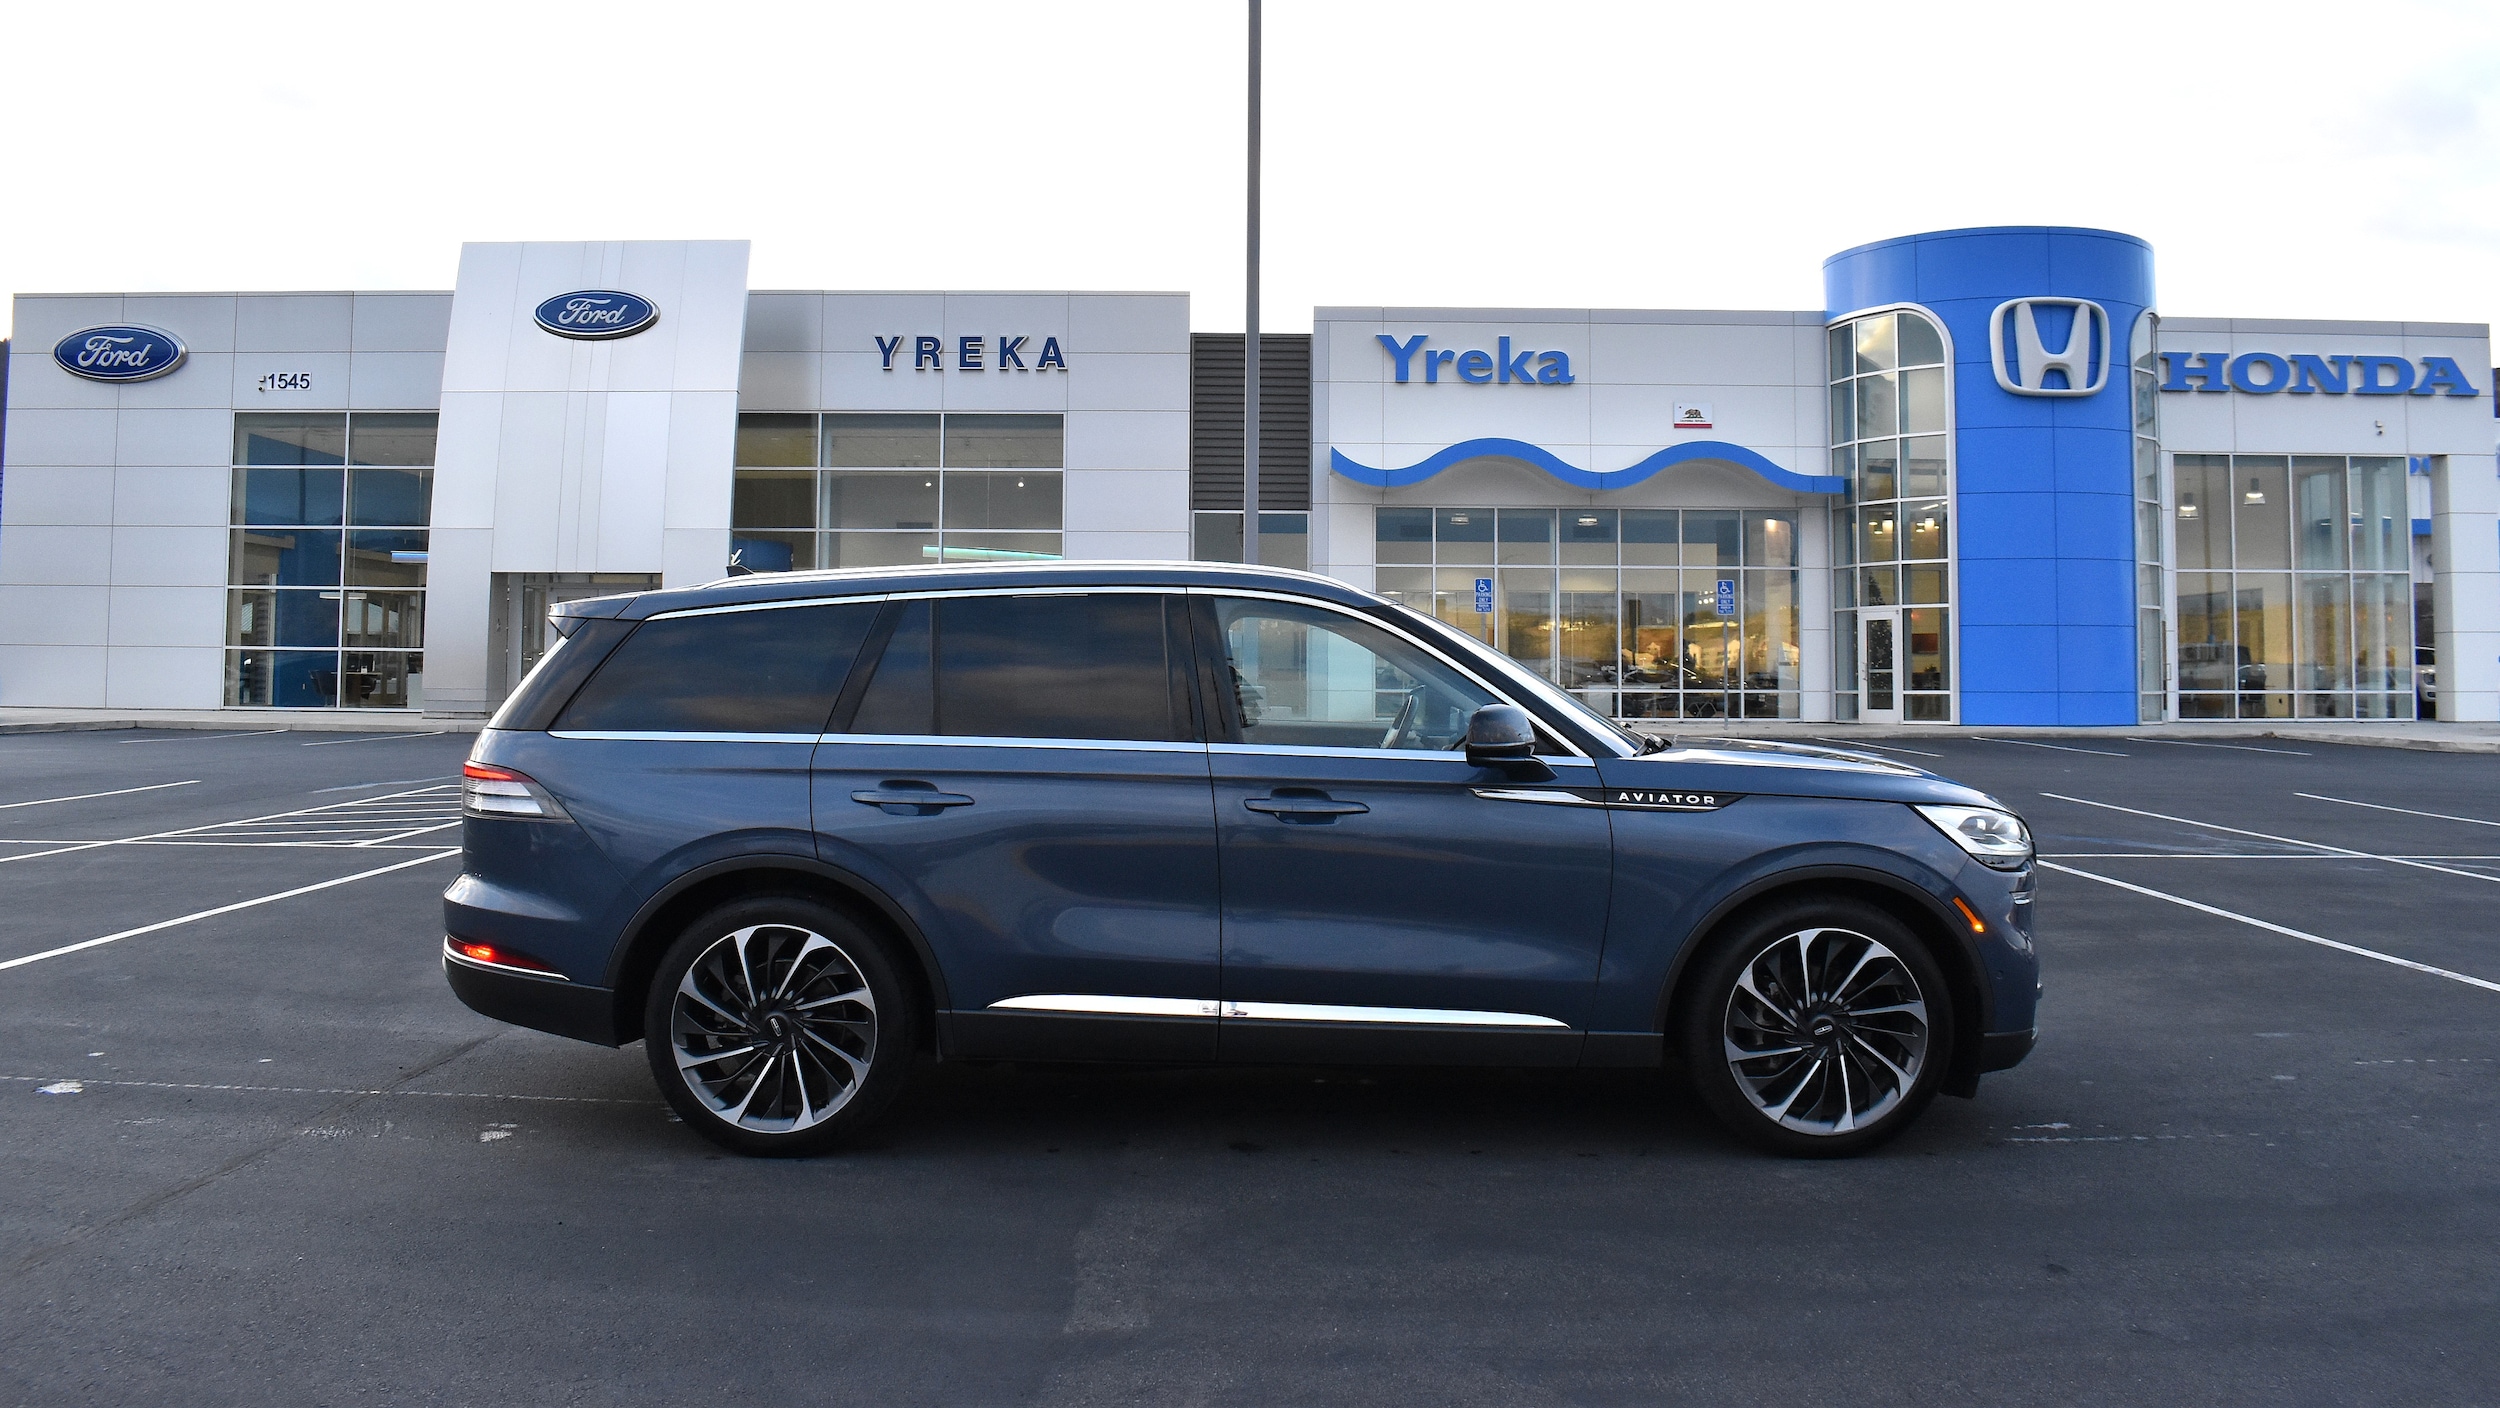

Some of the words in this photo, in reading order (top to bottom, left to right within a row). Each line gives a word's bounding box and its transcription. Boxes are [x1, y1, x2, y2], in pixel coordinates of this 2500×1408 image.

[558, 297, 628, 325] Ford
[77, 335, 152, 367] Ford
[873, 334, 1068, 371] YREKA
[1375, 334, 1576, 385] Yreka
[268, 373, 310, 389] 1545
[2159, 351, 2480, 397] HONDA
[1619, 792, 1715, 805] AVIATOR
